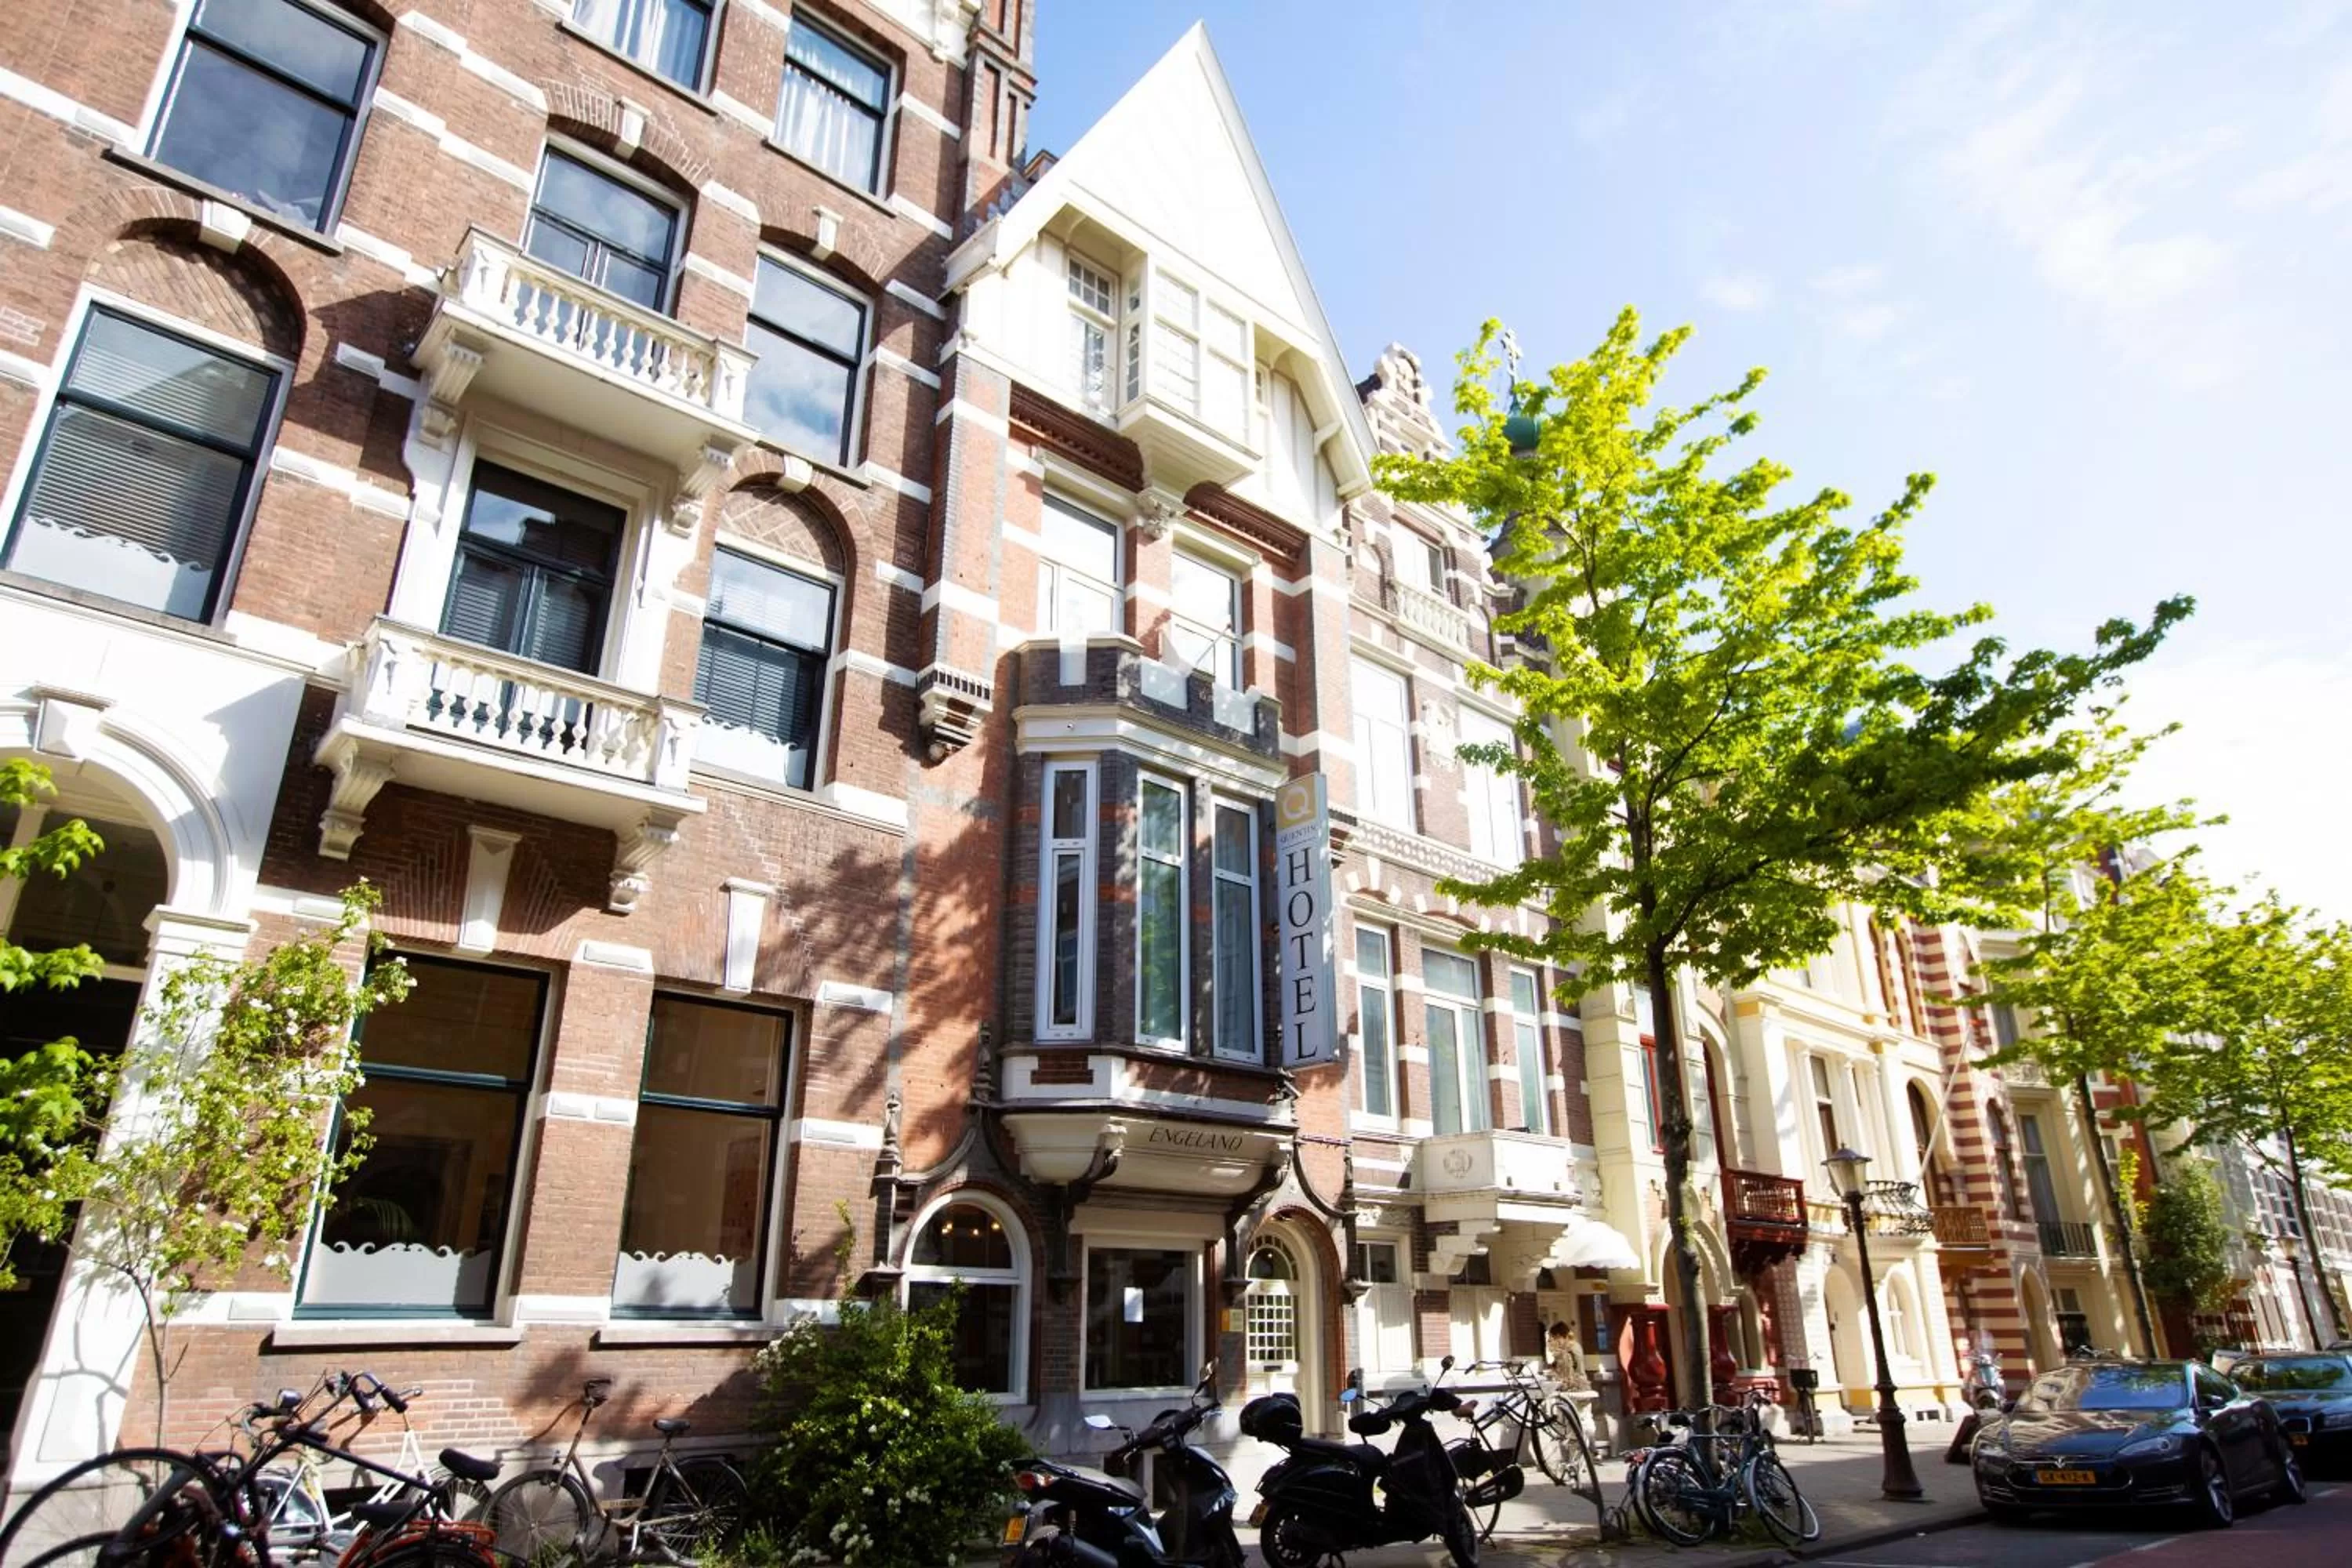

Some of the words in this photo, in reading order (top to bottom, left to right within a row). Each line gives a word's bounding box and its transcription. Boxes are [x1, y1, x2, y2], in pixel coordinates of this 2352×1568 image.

[1283, 786, 1312, 819] Q
[1286, 847, 1317, 1060] HOTEL
[1149, 1127, 1243, 1150] ENGELAND
